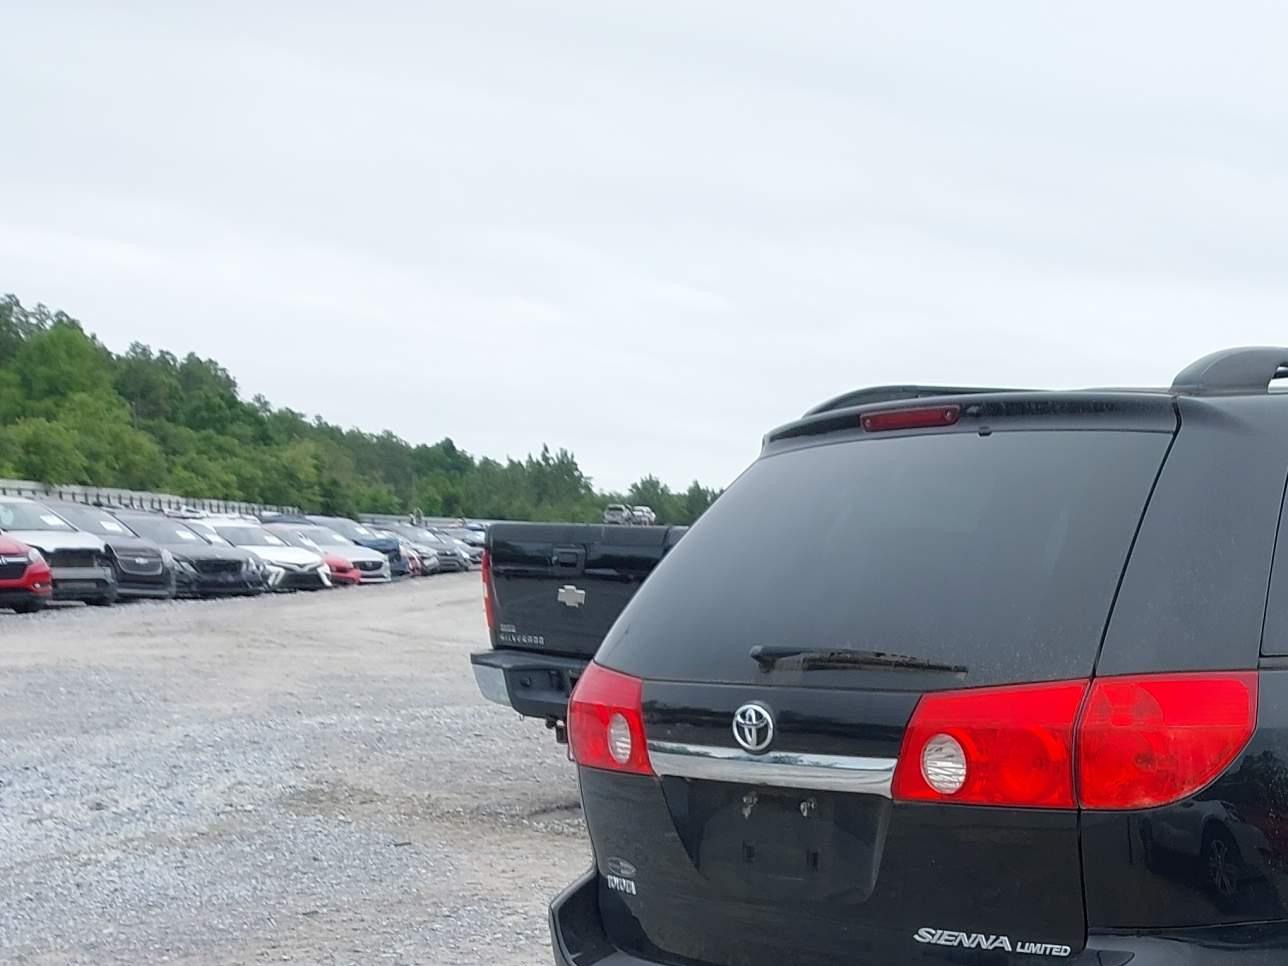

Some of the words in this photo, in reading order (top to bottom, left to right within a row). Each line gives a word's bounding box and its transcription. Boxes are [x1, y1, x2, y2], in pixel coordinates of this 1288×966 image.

[607, 874, 637, 896] TOYOTA
[913, 927, 1012, 952] SIENNA
[1015, 941, 1071, 957] LIMITED
